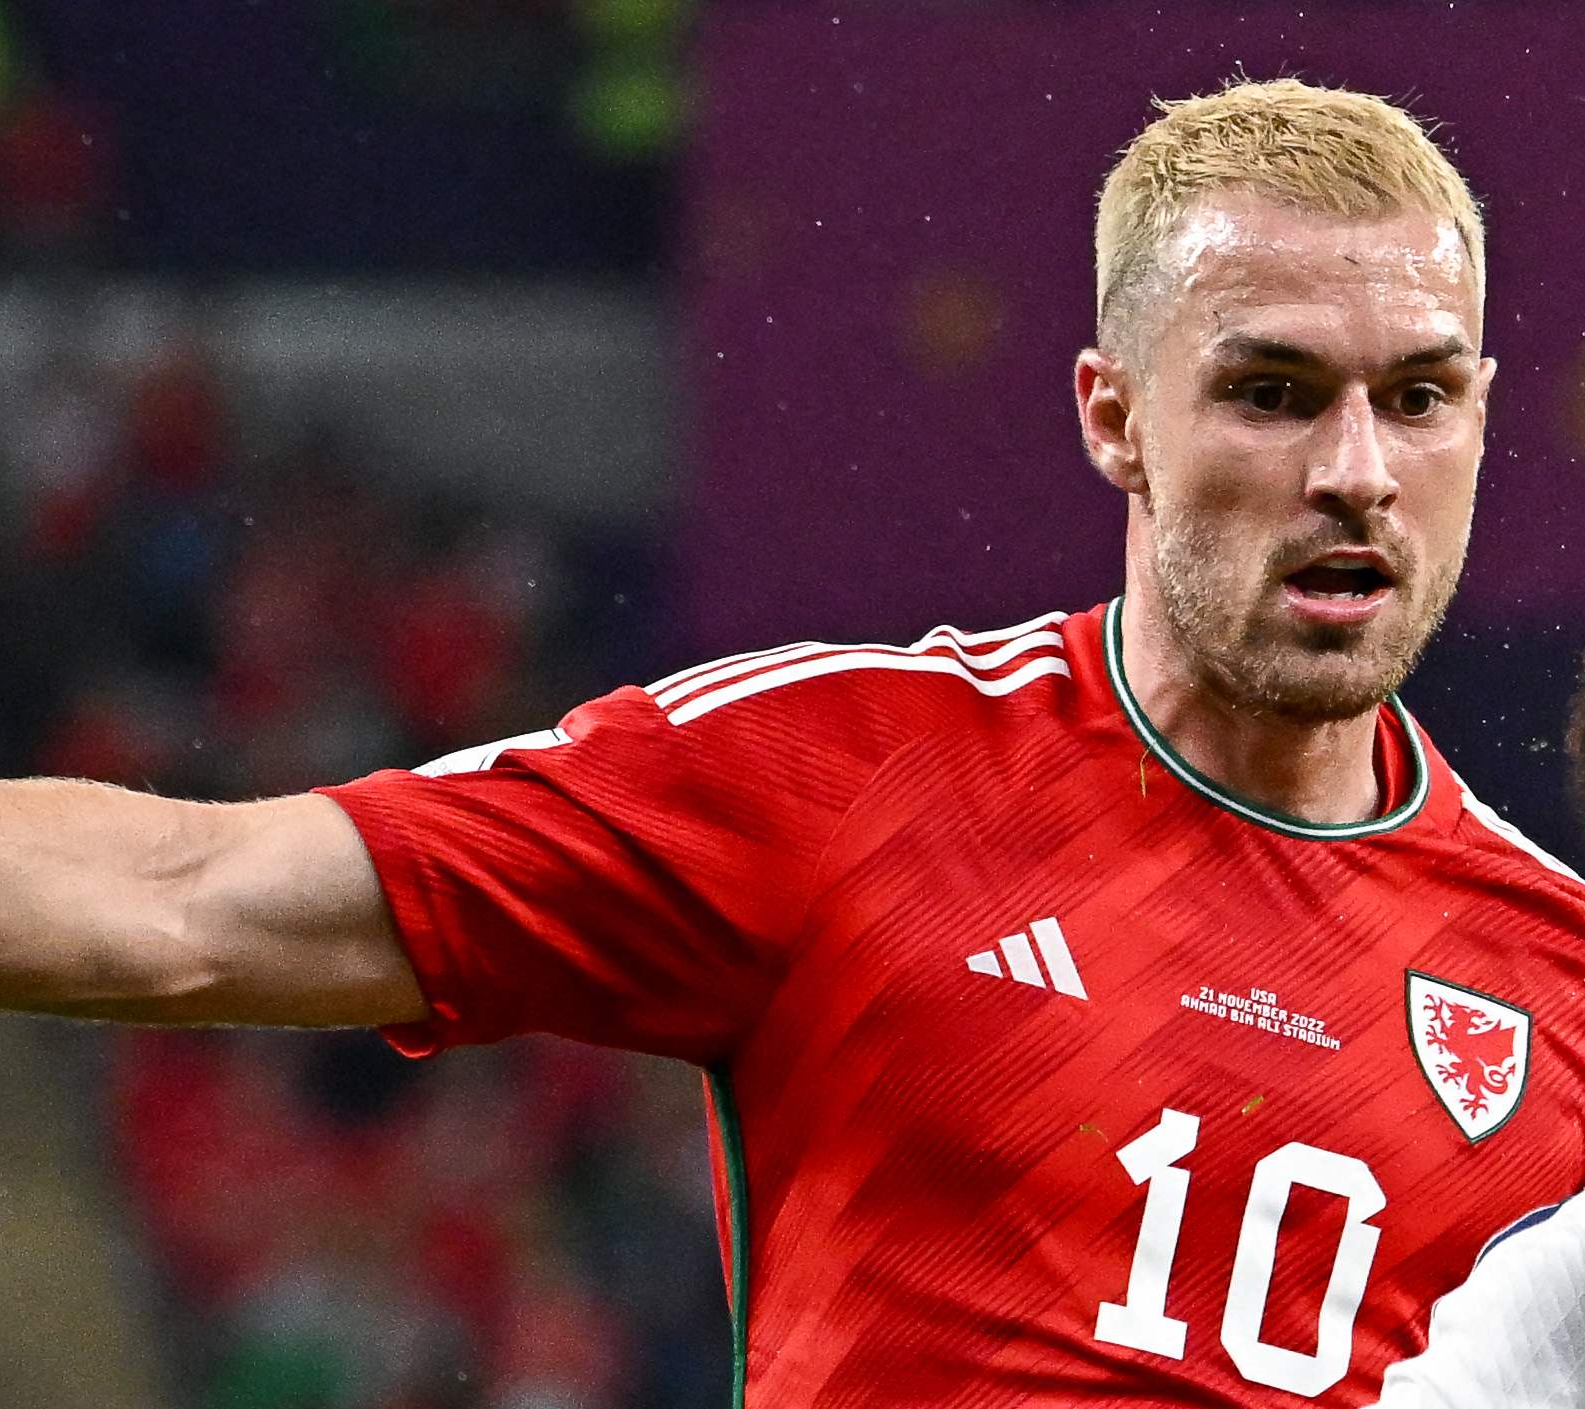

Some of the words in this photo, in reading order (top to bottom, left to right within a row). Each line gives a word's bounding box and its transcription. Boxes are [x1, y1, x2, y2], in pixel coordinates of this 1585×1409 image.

[1199, 987, 1214, 1001] 21
[1218, 992, 1288, 1023] NOVEMBER
[1291, 1013, 1325, 1033] 2022
[1250, 988, 1277, 1005] USA
[1180, 995, 1227, 1018] AHMAD
[1230, 1008, 1254, 1025] BIN
[1257, 1017, 1280, 1034] ALI
[1283, 1024, 1341, 1050] STADIUM
[1094, 1107, 1386, 1397] 10
